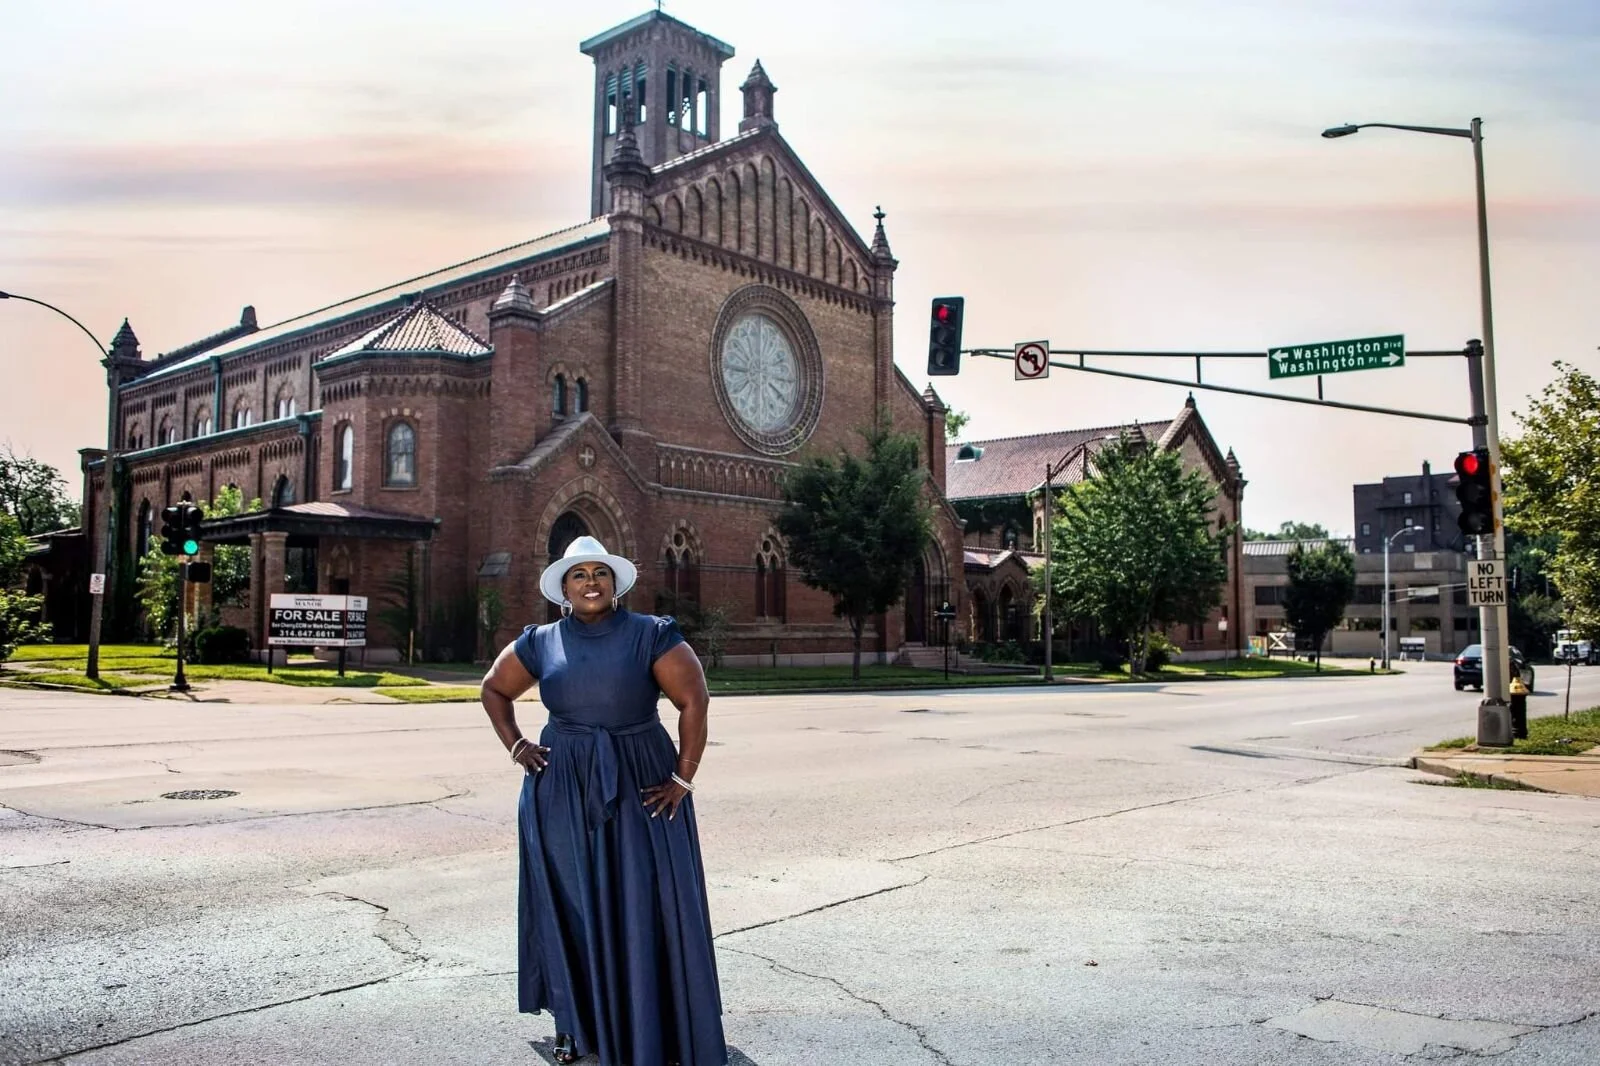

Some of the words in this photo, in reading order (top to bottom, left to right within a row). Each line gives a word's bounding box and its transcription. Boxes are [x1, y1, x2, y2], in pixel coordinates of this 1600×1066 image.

[1293, 342, 1380, 360] Washington
[1279, 356, 1364, 374] Washington
[1477, 563, 1494, 575] NO
[1470, 576, 1502, 589] LEFT
[1471, 591, 1504, 603] TURN
[275, 610, 302, 620] FOR
[305, 611, 340, 621] SALE
